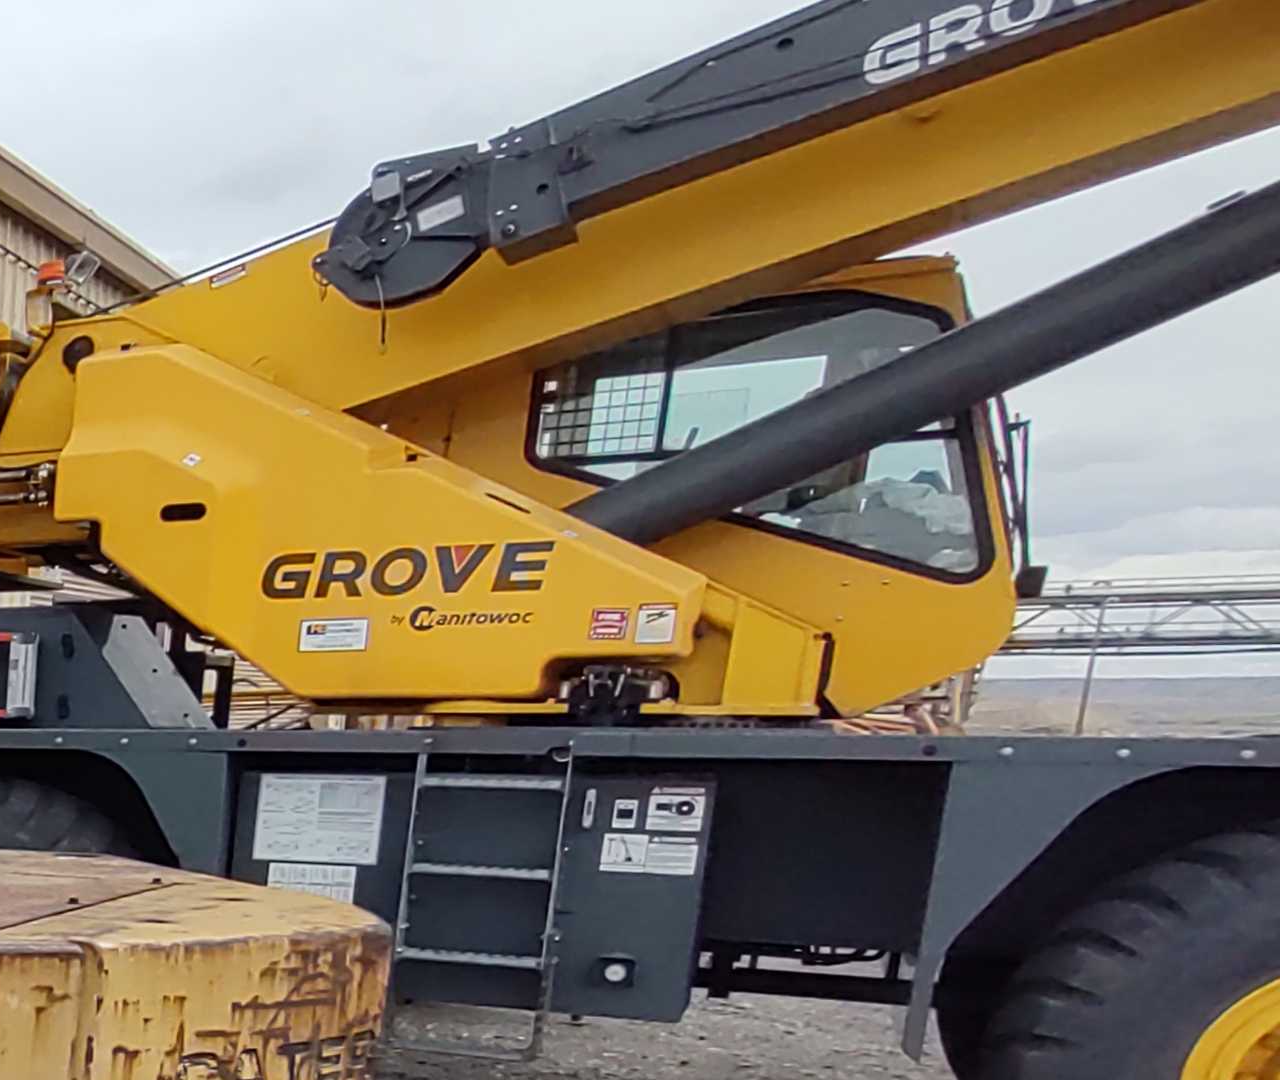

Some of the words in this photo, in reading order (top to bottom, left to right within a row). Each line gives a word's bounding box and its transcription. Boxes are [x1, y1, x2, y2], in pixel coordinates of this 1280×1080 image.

[863, 0, 1097, 85] GRO
[261, 541, 556, 599] GROVE
[390, 614, 405, 626] by
[409, 605, 535, 632] Manitowoc
